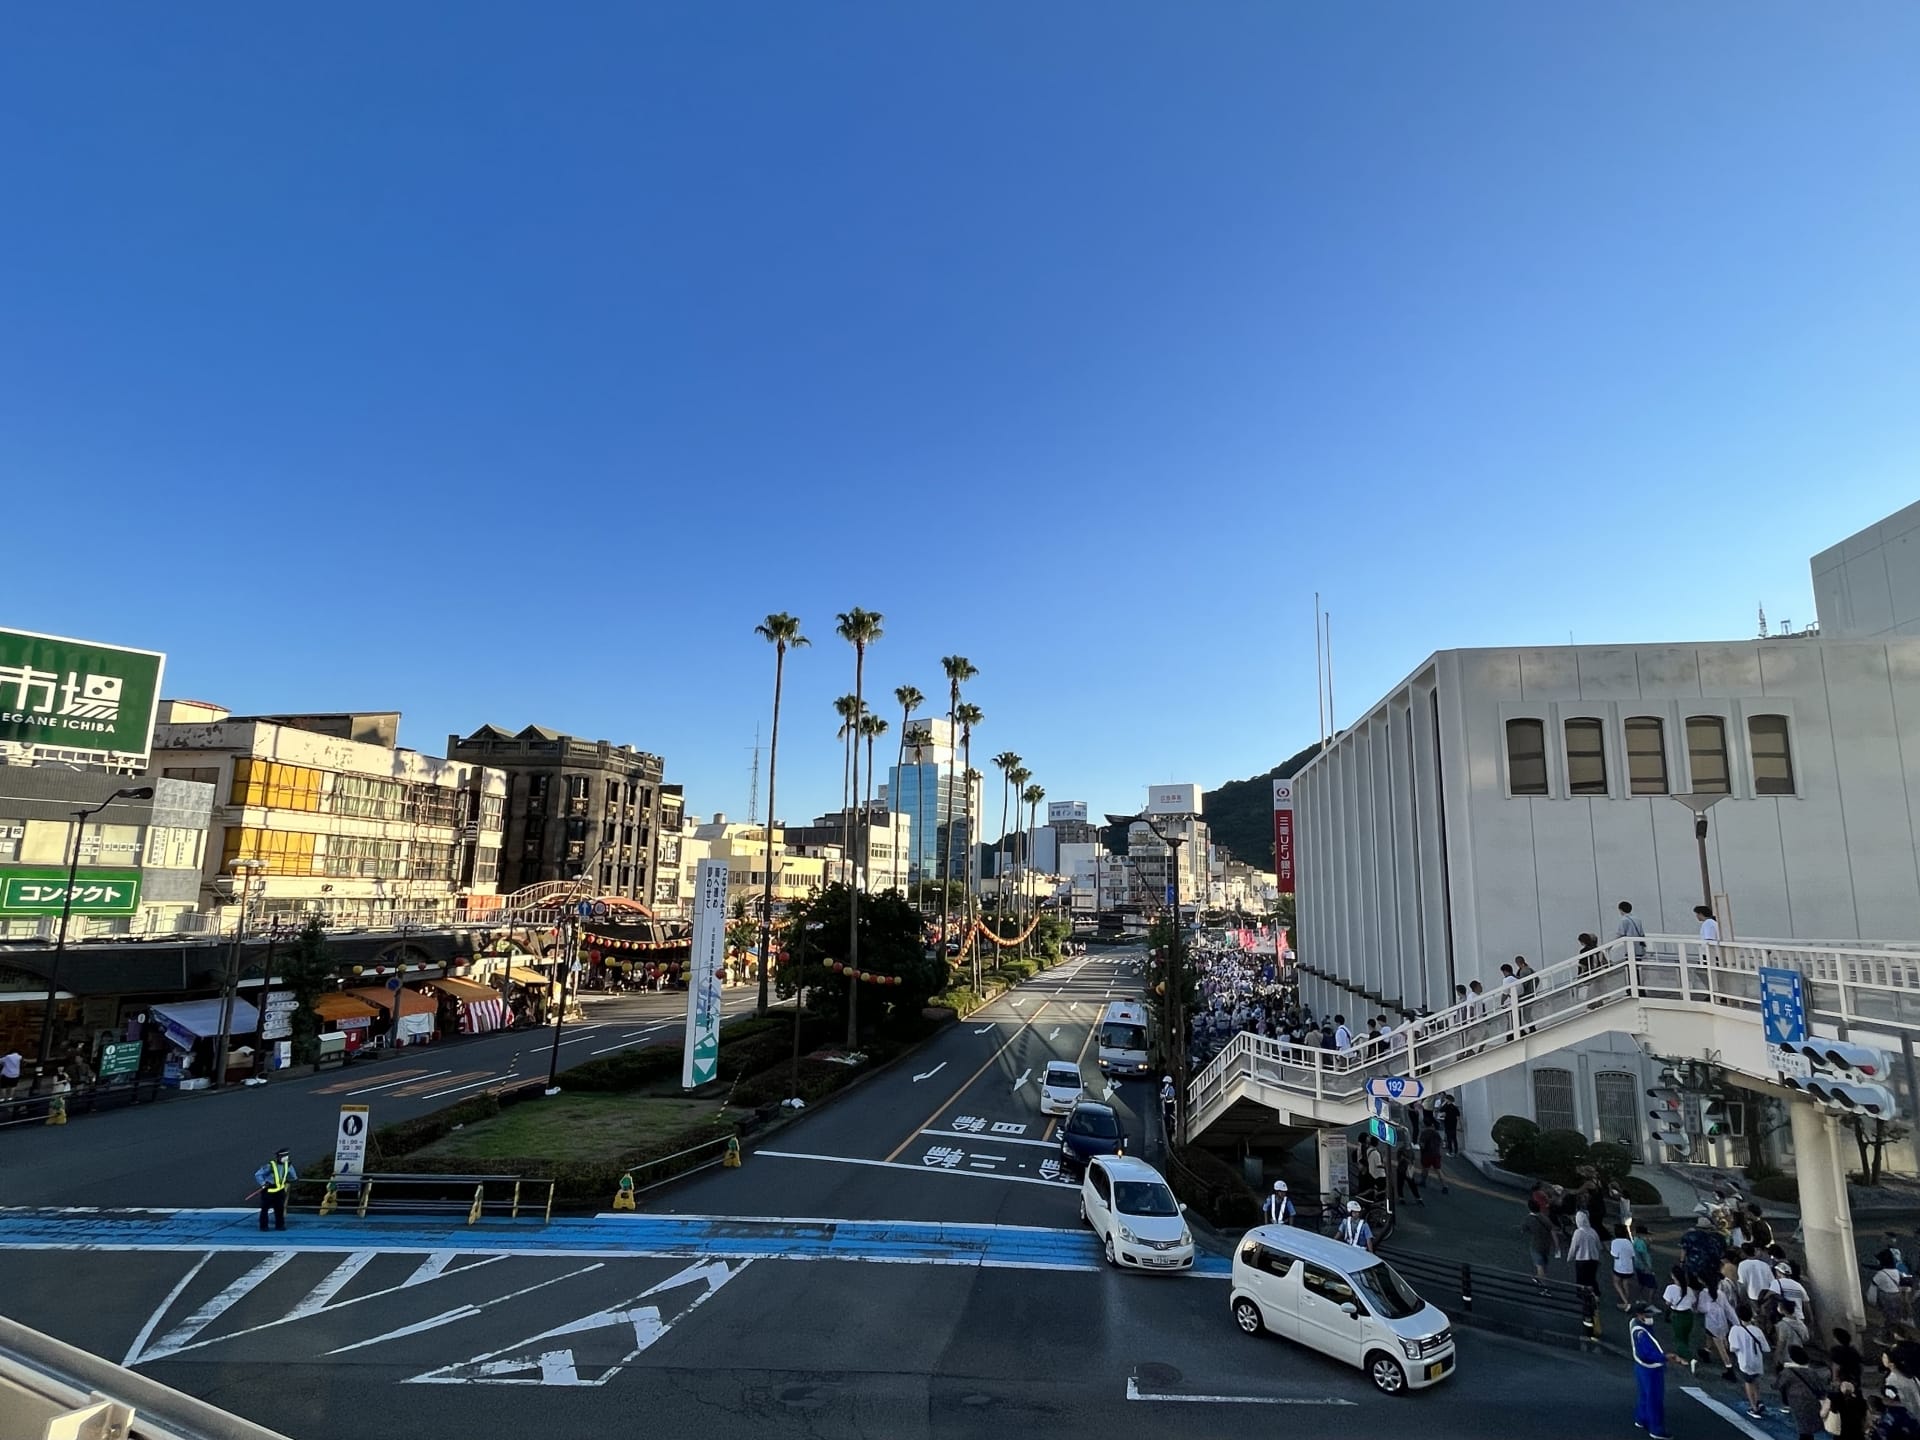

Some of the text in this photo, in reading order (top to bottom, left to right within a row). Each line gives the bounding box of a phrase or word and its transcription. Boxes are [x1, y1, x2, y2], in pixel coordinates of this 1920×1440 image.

[63, 719, 115, 734] ICHIBA
[19, 885, 122, 904] コンタクト
[1388, 1080, 1403, 1092] 192
